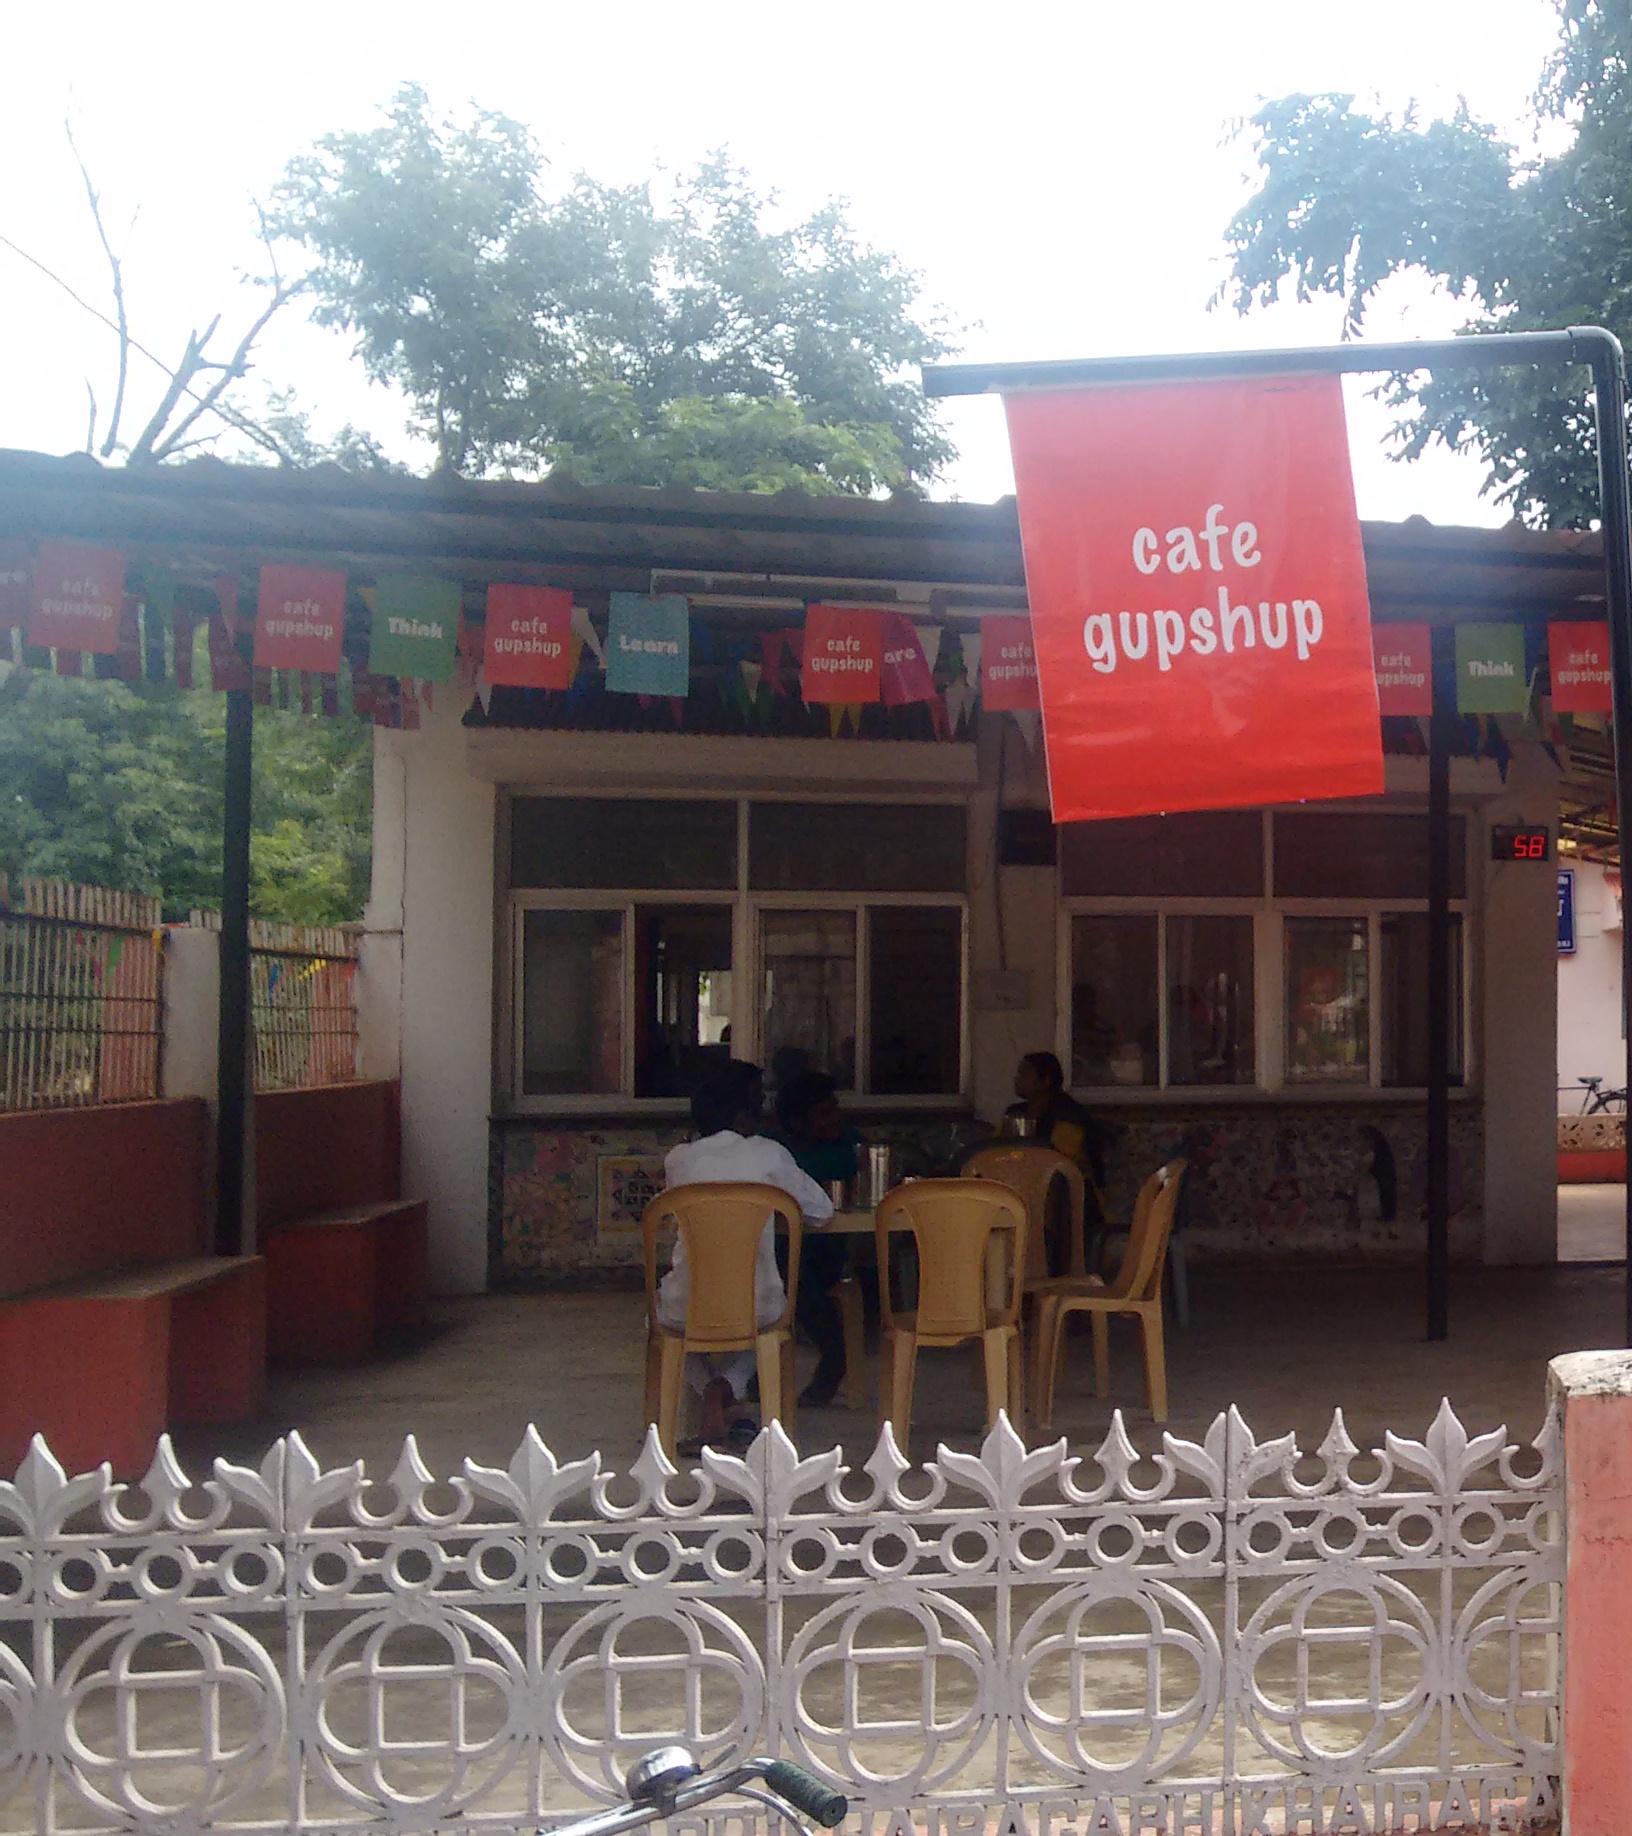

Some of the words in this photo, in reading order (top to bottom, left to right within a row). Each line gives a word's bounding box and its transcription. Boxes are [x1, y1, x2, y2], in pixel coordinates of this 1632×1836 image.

[1132, 504, 1261, 574] cafe
[284, 599, 320, 616] cafe
[266, 619, 334, 640] gupshup
[388, 617, 442, 639] Think
[511, 616, 547, 634] cafe
[1083, 586, 1323, 673] gupshup
[494, 636, 562, 658] gupshup
[620, 634, 679, 654] Learn
[827, 635, 860, 652] cafe
[1001, 642, 1031, 659] cafe
[884, 647, 916, 664] are
[1381, 651, 1412, 667] cafe
[1569, 650, 1598, 665] cafe
[811, 656, 873, 673] gupshup
[989, 661, 1036, 680] gupshu
[1467, 660, 1514, 677] Think
[1375, 670, 1426, 687] upshup
[1557, 668, 1611, 685] gupshup
[1514, 835, 1545, 857] 58
